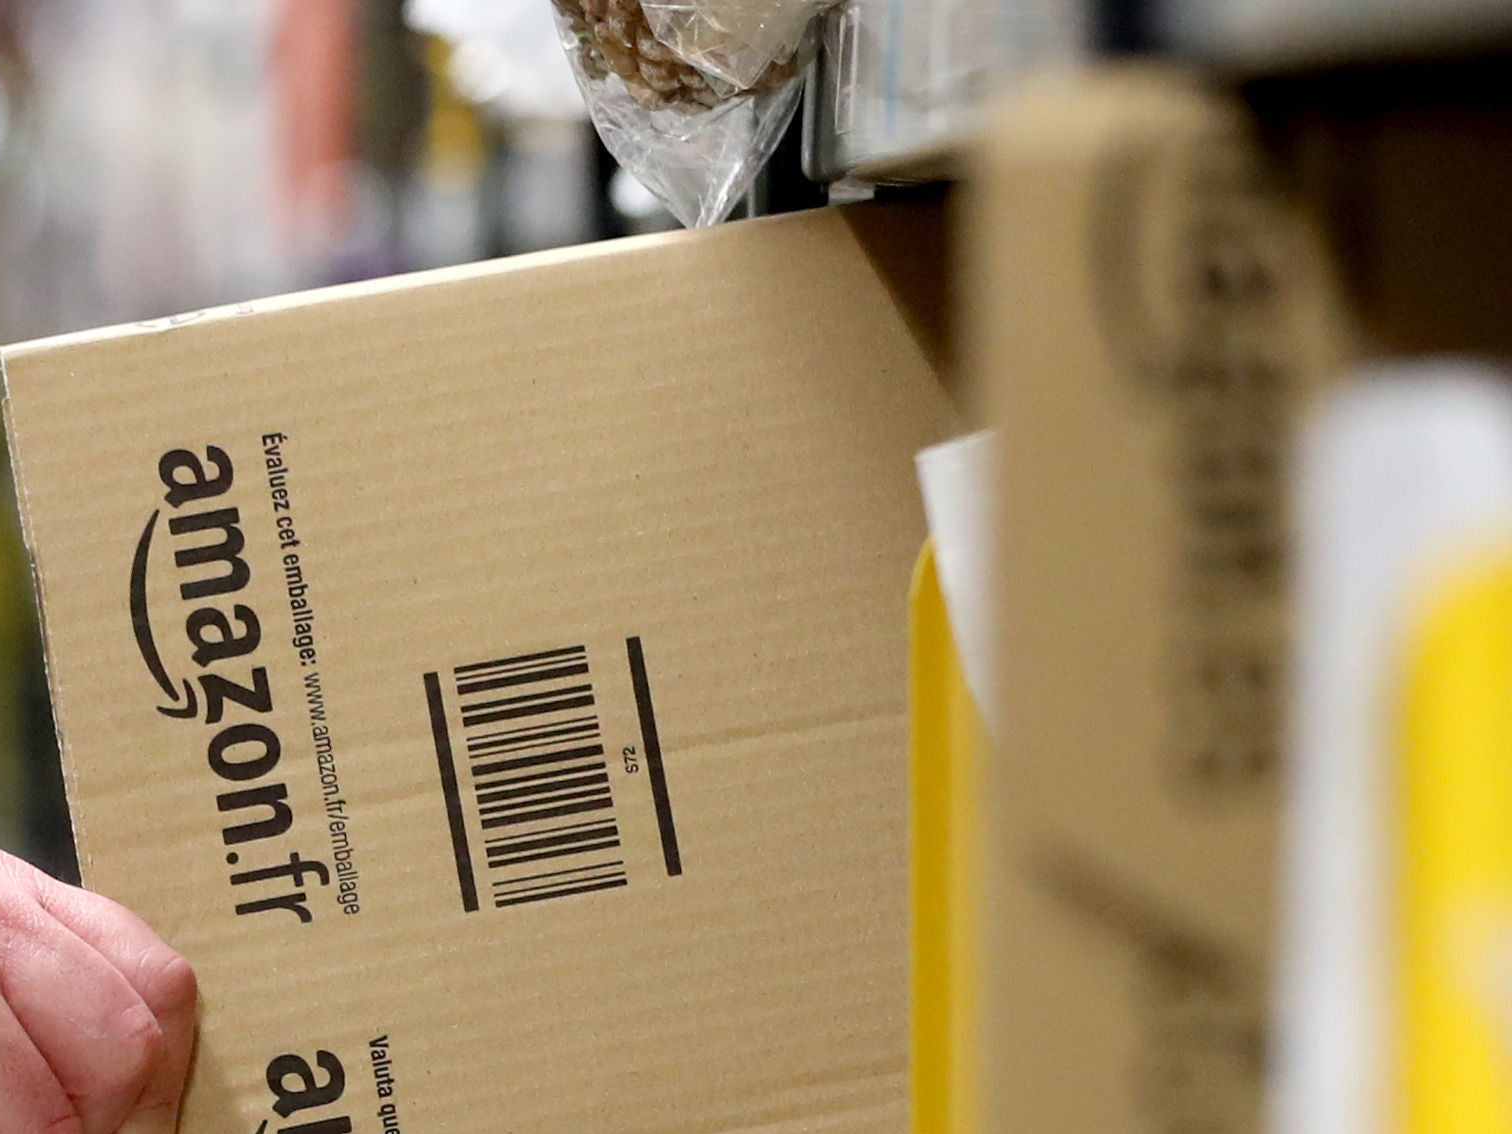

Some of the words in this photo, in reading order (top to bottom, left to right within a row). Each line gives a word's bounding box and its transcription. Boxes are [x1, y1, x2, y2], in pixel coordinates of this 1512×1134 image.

[261, 431, 291, 513] Évaluez
[275, 515, 301, 551] cet
[282, 553, 317, 667] emballage:
[158, 445, 330, 923] amazon.fr
[303, 672, 361, 916] www.amazon.fr/emballage
[622, 746, 639, 774] S72
[368, 1034, 396, 1100] Valuta
